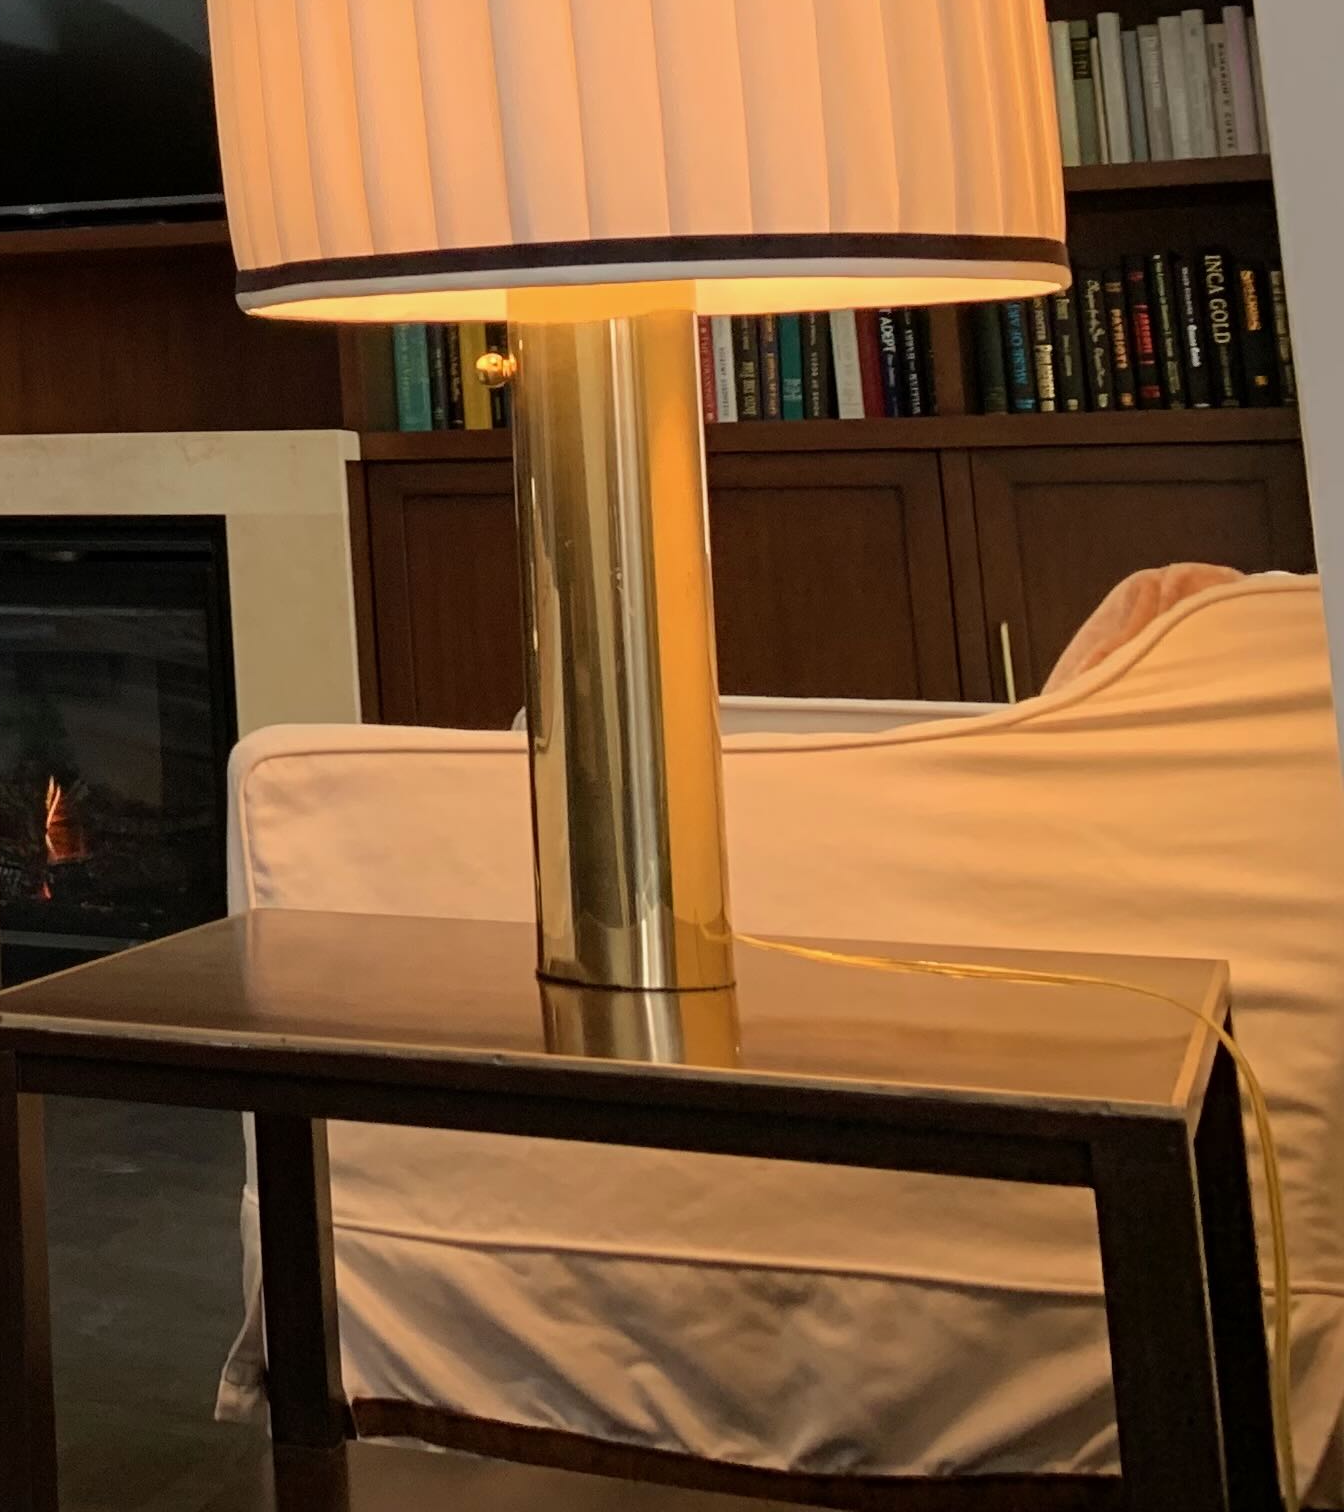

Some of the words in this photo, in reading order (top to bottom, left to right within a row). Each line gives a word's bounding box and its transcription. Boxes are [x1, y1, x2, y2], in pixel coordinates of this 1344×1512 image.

[1204, 254, 1225, 295] INCA
[879, 317, 896, 353] ADEPT
[1209, 298, 1231, 344] GOLD
[909, 374, 921, 414] WILLIAM
